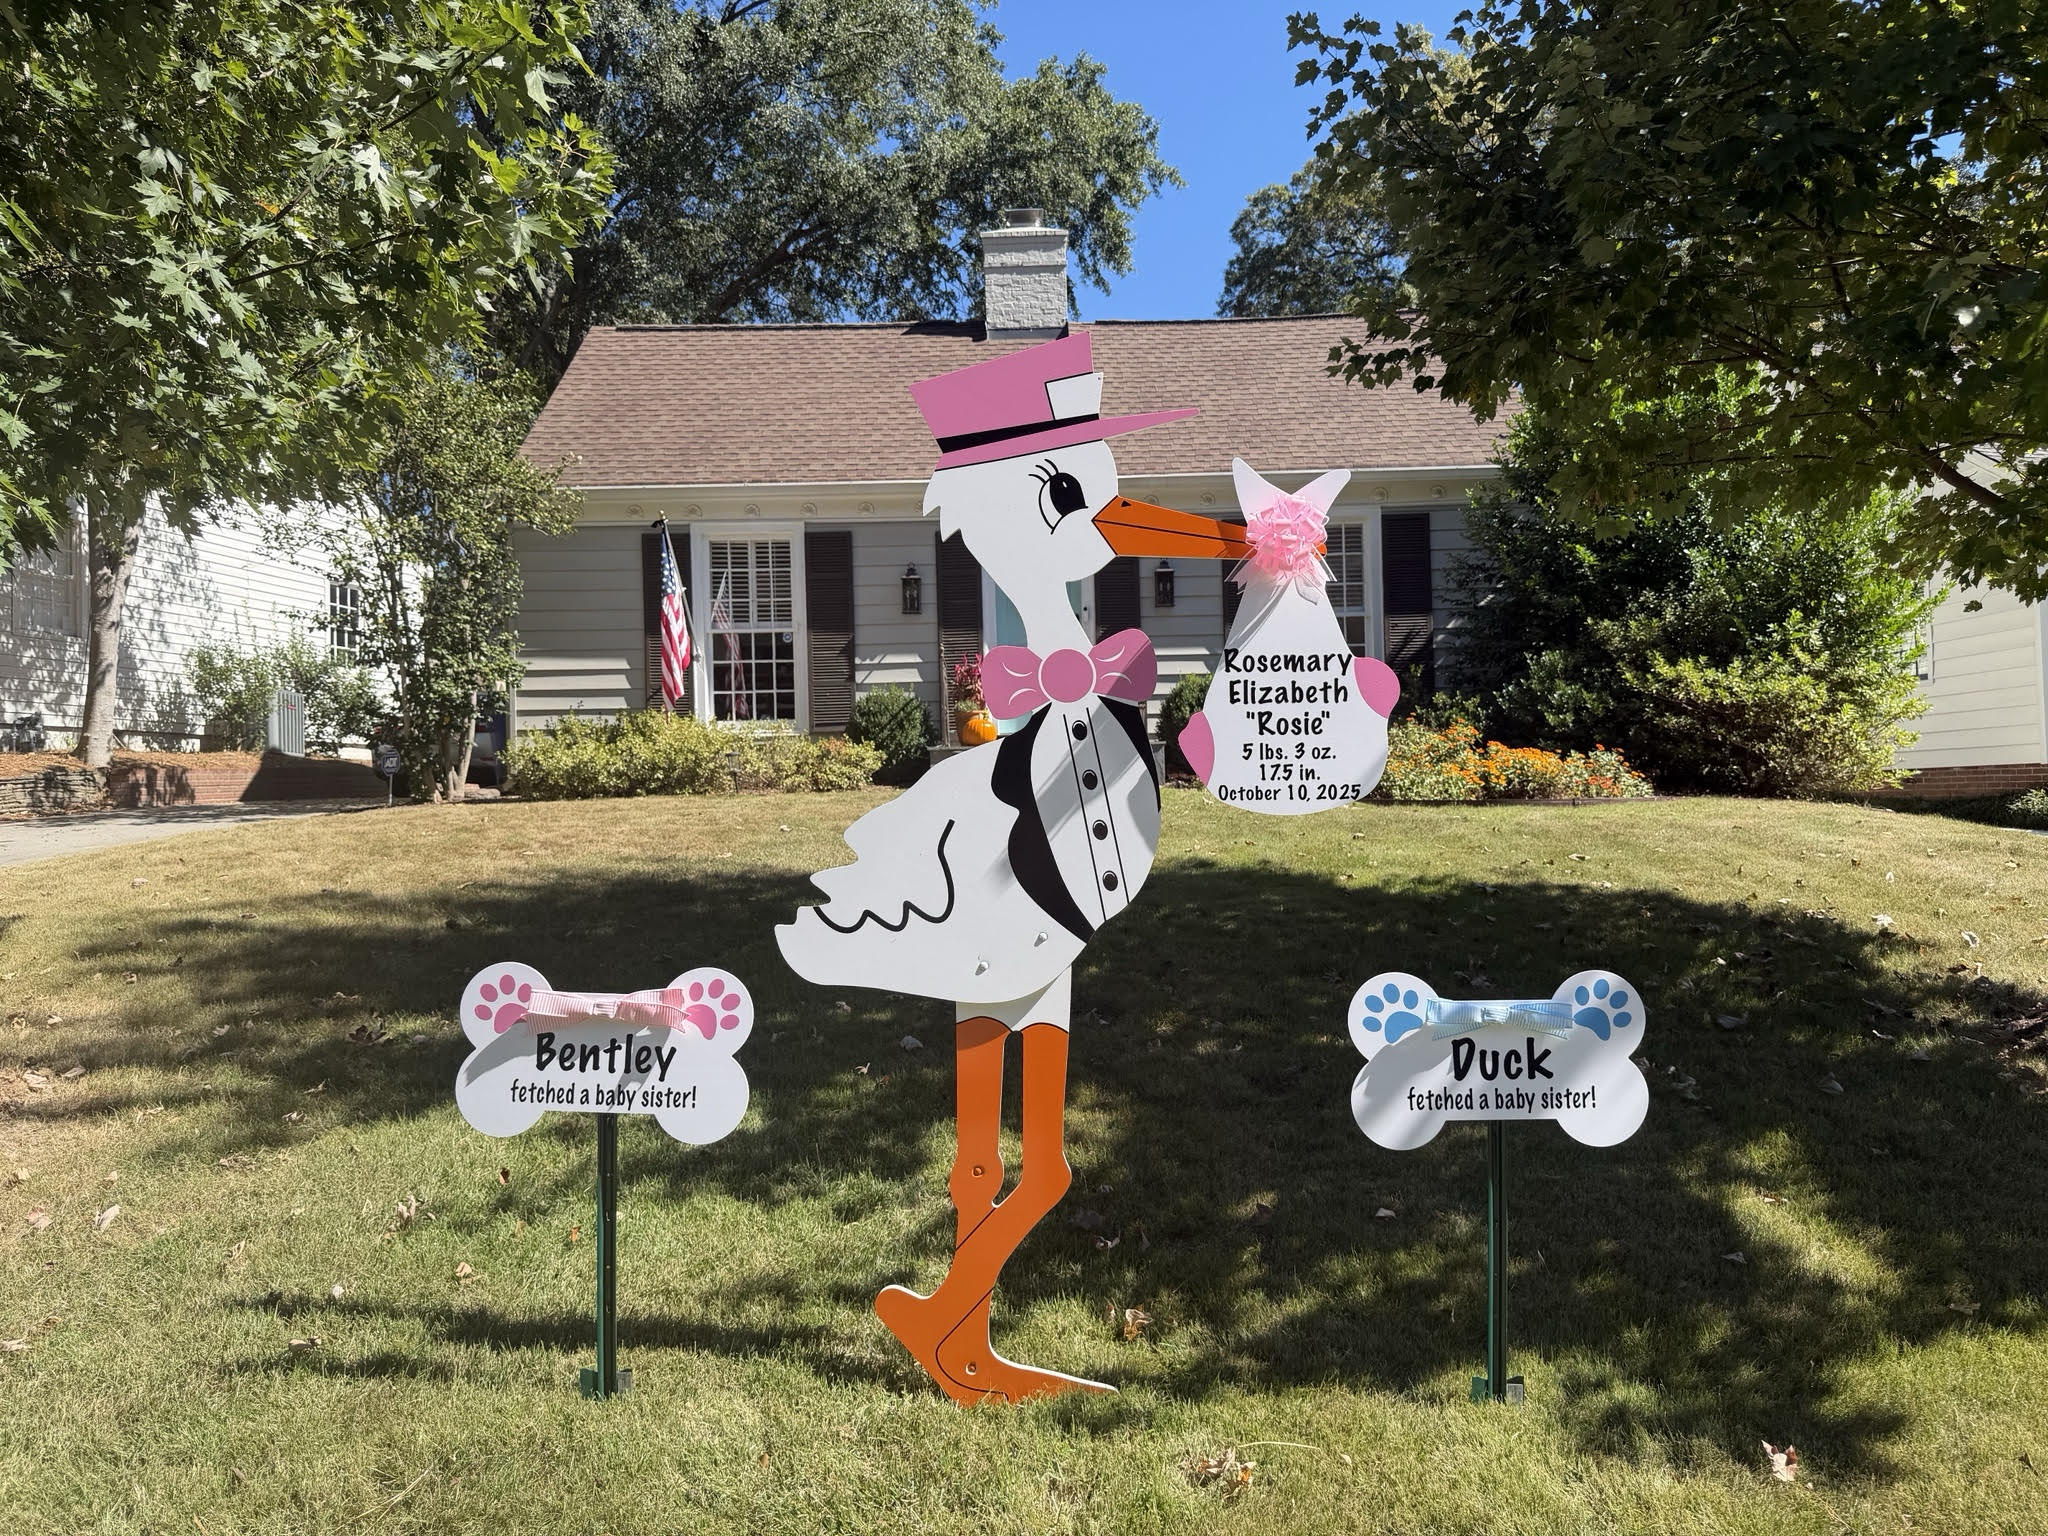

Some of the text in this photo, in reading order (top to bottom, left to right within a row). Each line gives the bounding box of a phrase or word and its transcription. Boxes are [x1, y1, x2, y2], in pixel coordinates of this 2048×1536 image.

[1223, 648, 1353, 676] Rosemary
[1229, 678, 1348, 704] Elizabeth
[1246, 711, 1330, 735] "Rosie"
[1242, 743, 1337, 760] 5 lbs. 3 oz.
[1260, 764, 1321, 781] 17.5 in.
[1218, 784, 1361, 802] October 10, 2025
[535, 1032, 677, 1082] Bentley
[1451, 1037, 1553, 1081] Duck
[510, 1079, 697, 1110] fetched a baby sister!
[1407, 1086, 1596, 1113] fetched a baby sister!
